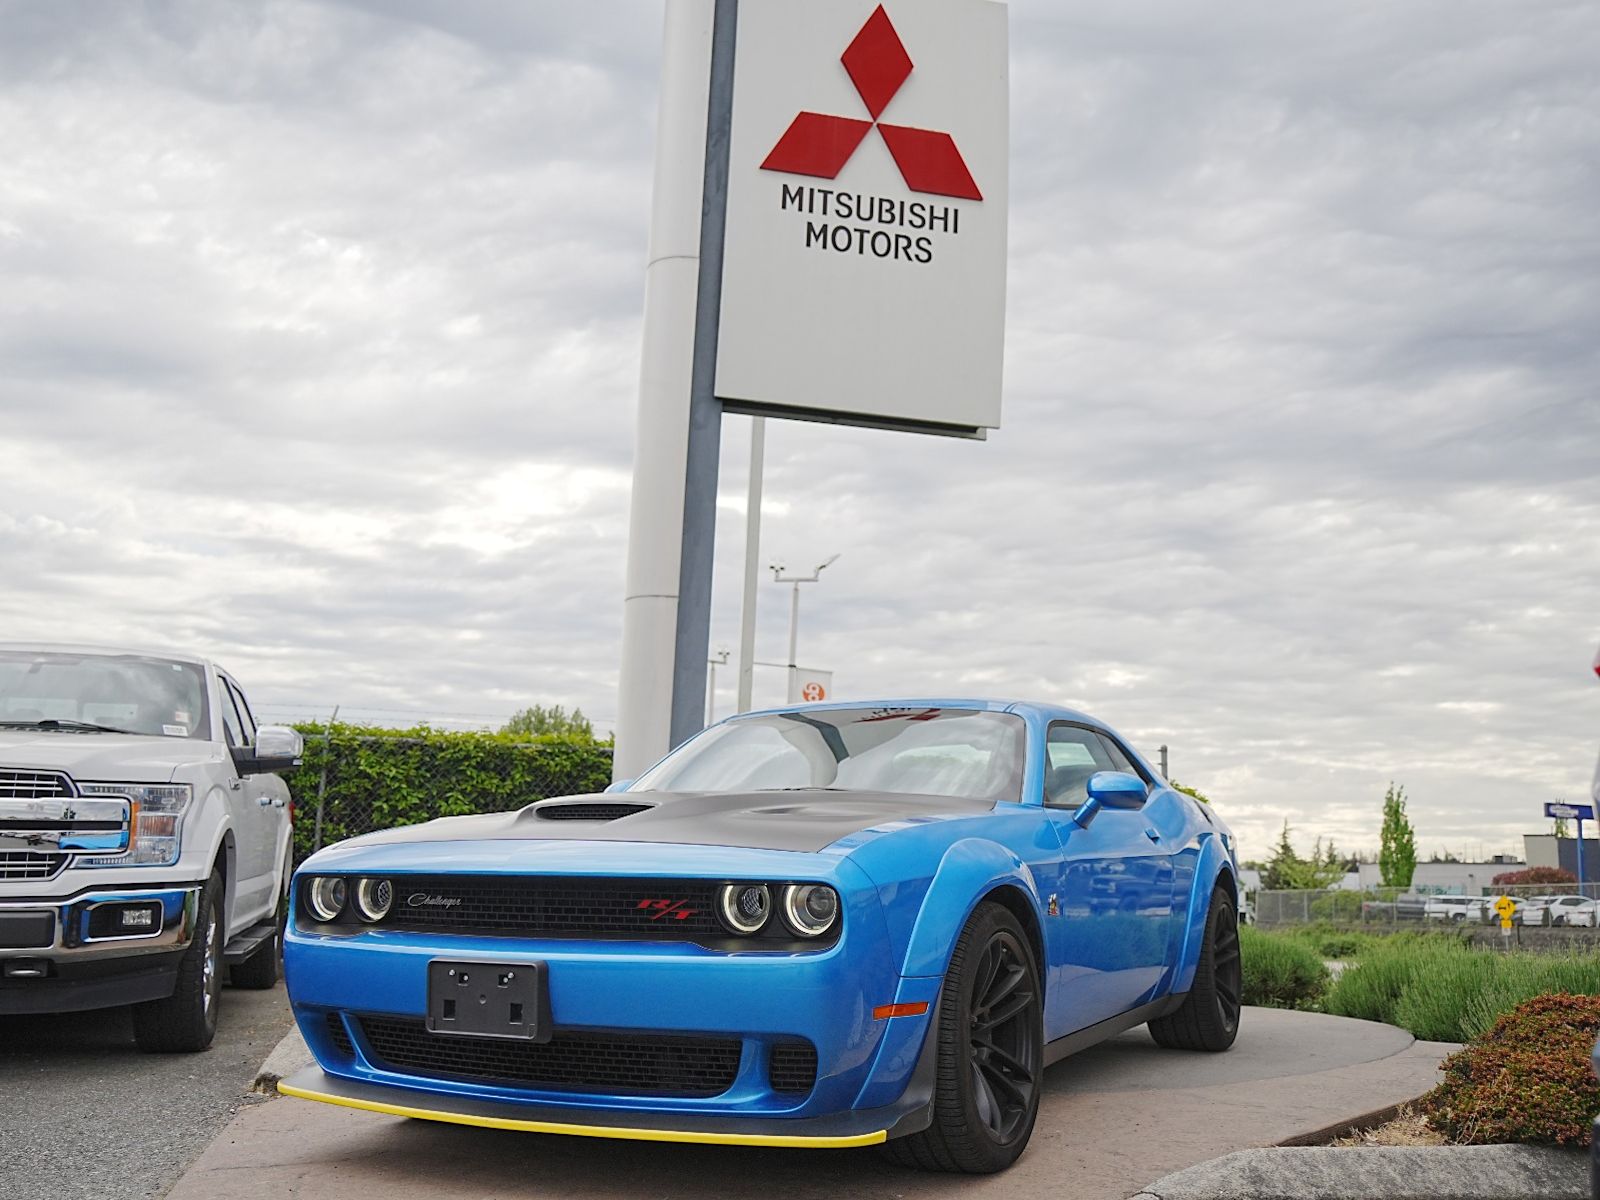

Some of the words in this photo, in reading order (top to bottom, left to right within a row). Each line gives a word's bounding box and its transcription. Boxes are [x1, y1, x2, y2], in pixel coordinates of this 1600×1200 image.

[781, 183, 959, 234] MITSUBISHI
[805, 221, 933, 264] MOTORS
[637, 899, 698, 920] R/T
